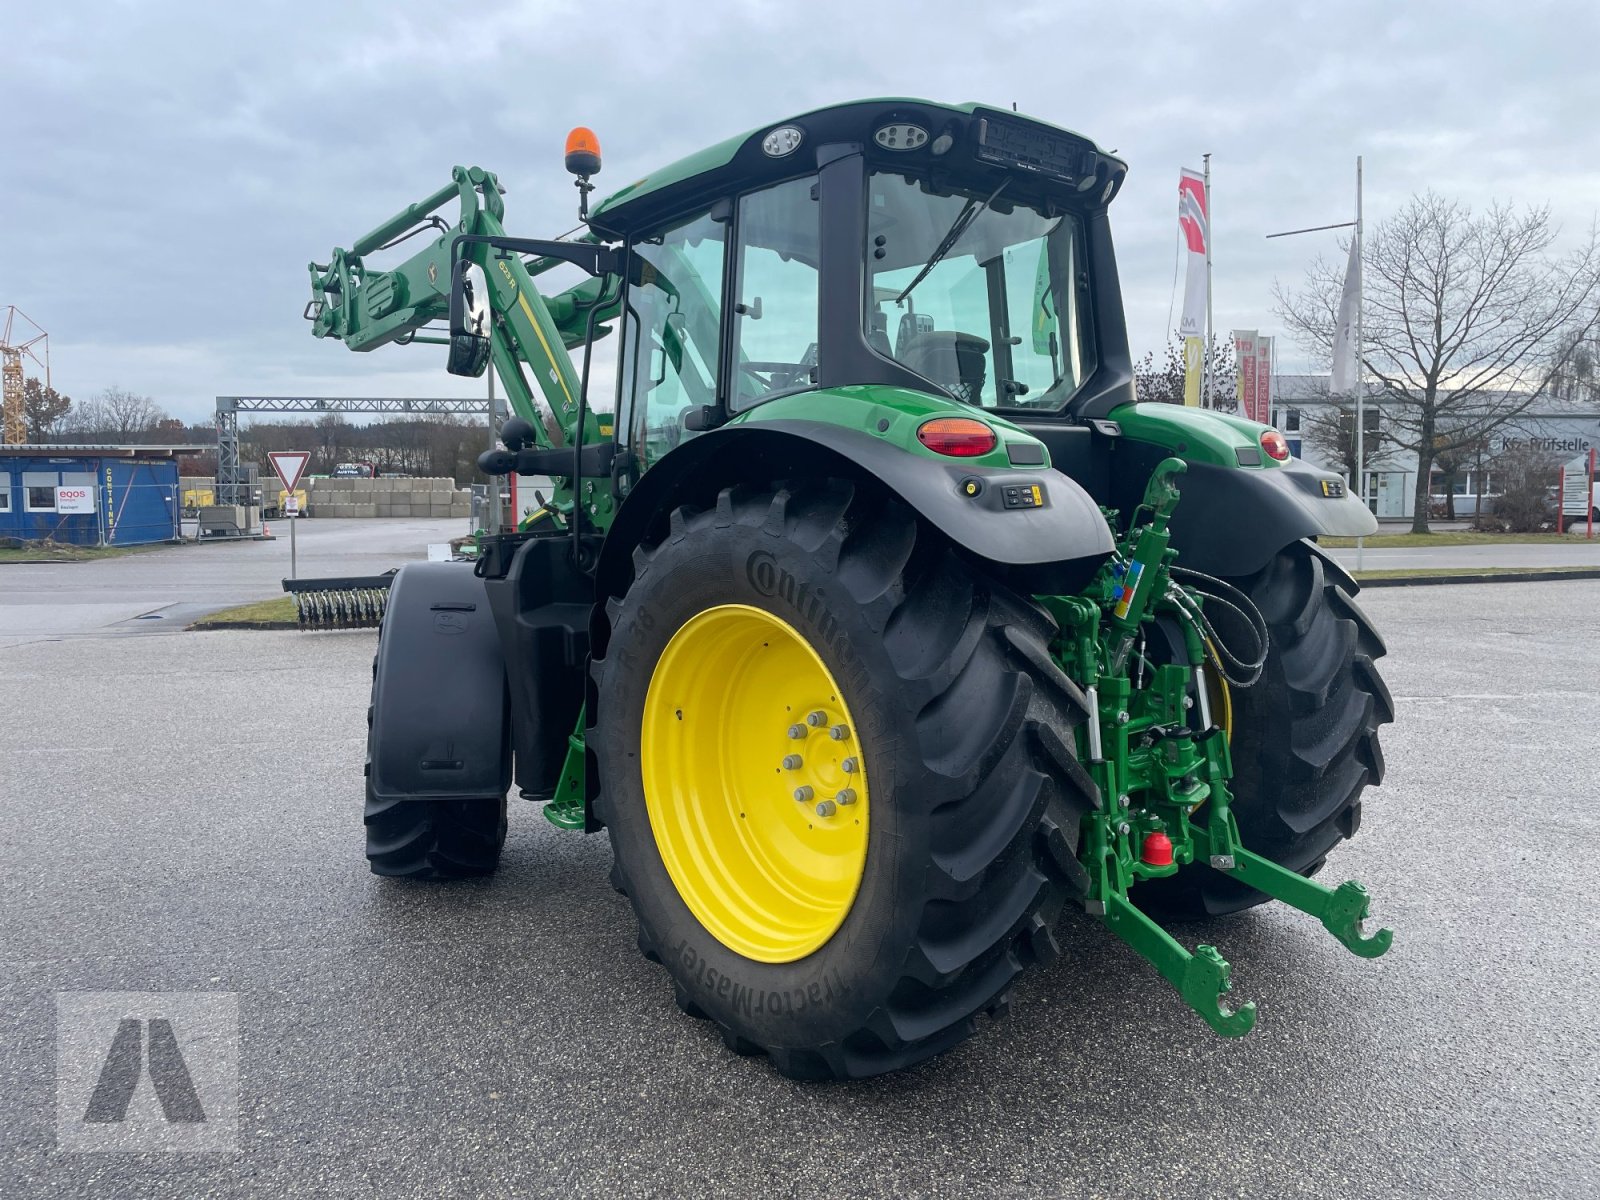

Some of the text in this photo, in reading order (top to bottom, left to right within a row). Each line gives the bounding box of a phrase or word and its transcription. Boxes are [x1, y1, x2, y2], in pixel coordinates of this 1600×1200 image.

[499, 261, 516, 289] 623 R
[674, 939, 850, 1019] TractorMaster
